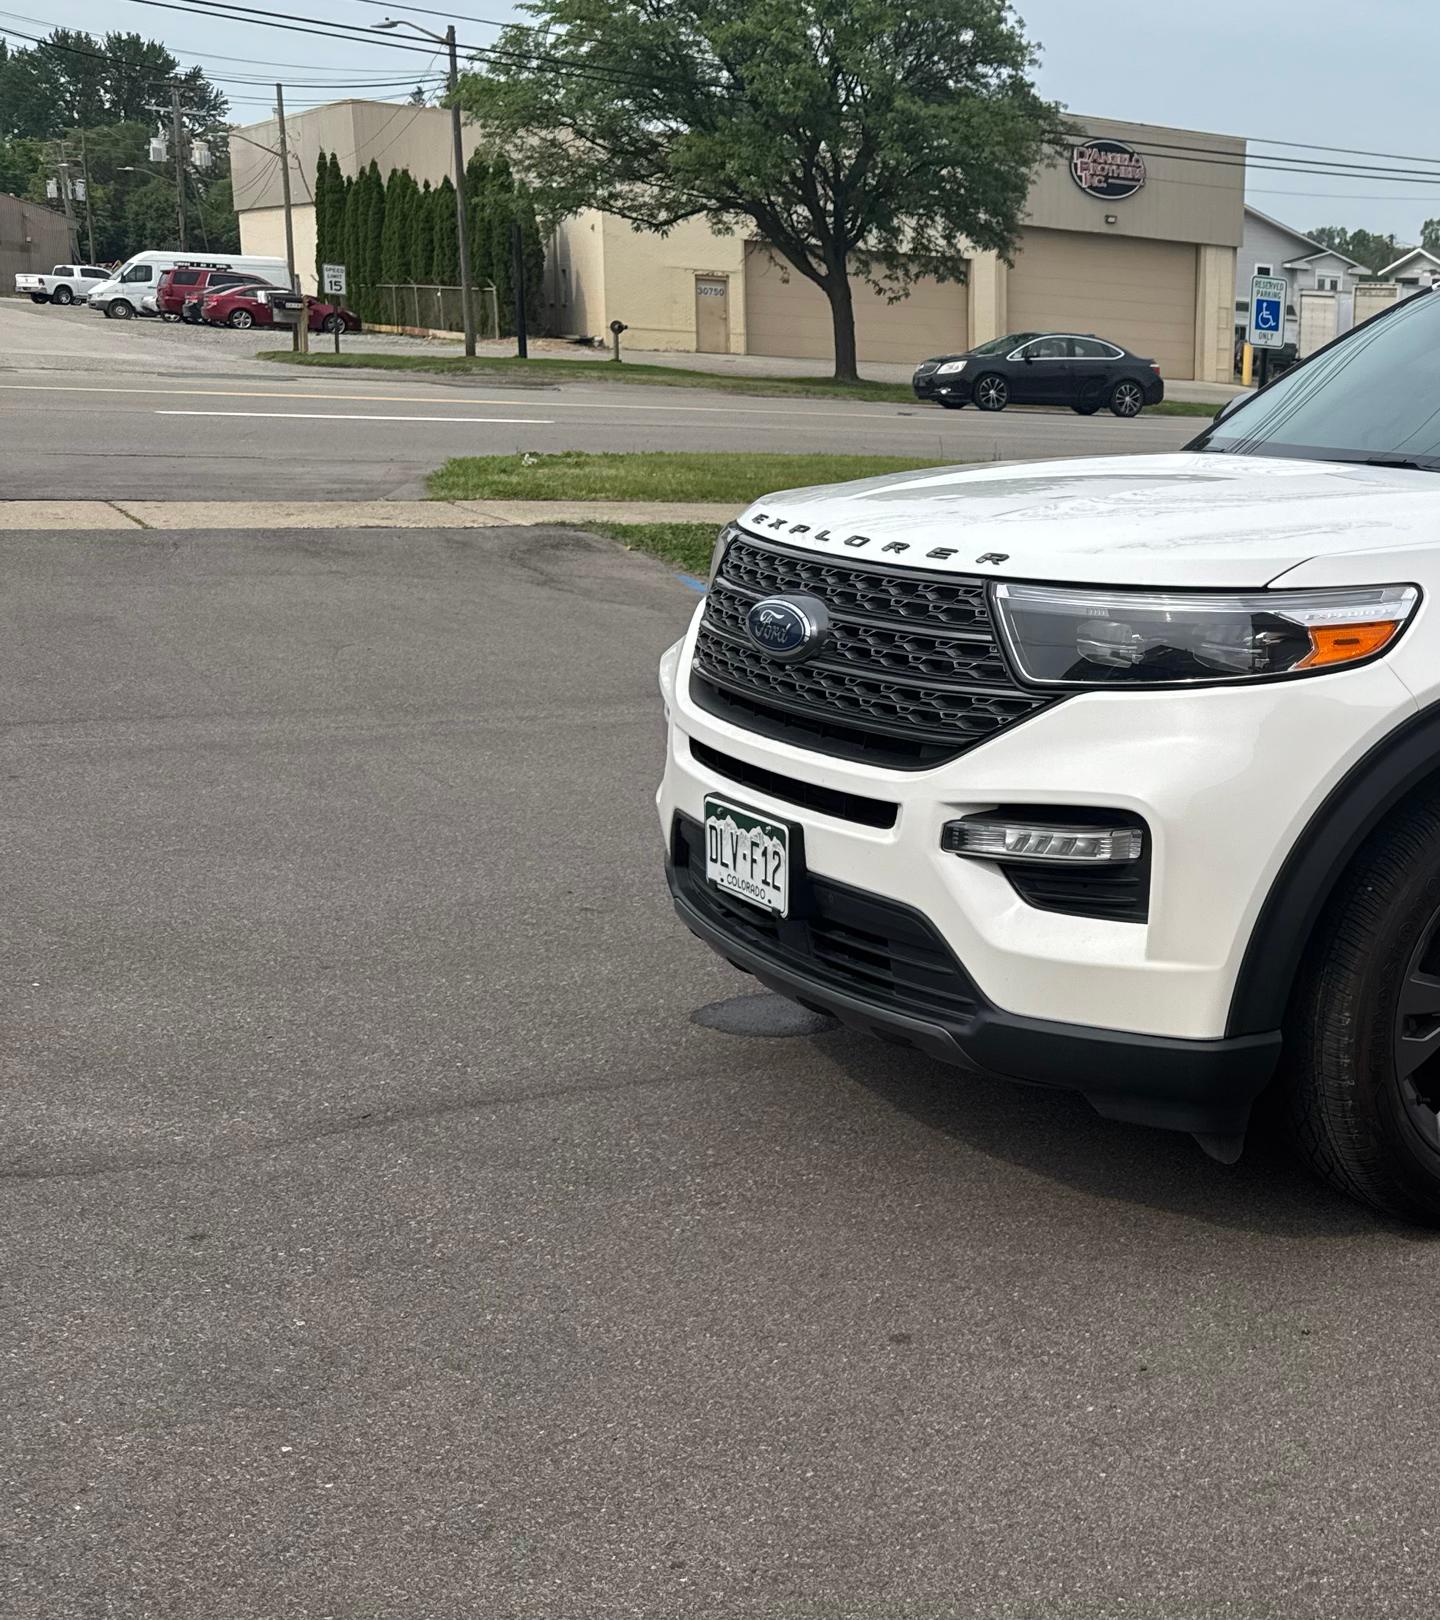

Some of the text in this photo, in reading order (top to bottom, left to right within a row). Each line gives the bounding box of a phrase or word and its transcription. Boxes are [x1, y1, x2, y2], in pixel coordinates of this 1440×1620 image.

[329, 280, 343, 291] 15
[1255, 280, 1284, 291] RESERVED
[1256, 289, 1281, 299] PARKING
[1258, 331, 1273, 341] ONLY
[751, 513, 1010, 566] EXPLORER
[754, 609, 792, 645] Ford
[726, 873, 766, 900] COLORADO
